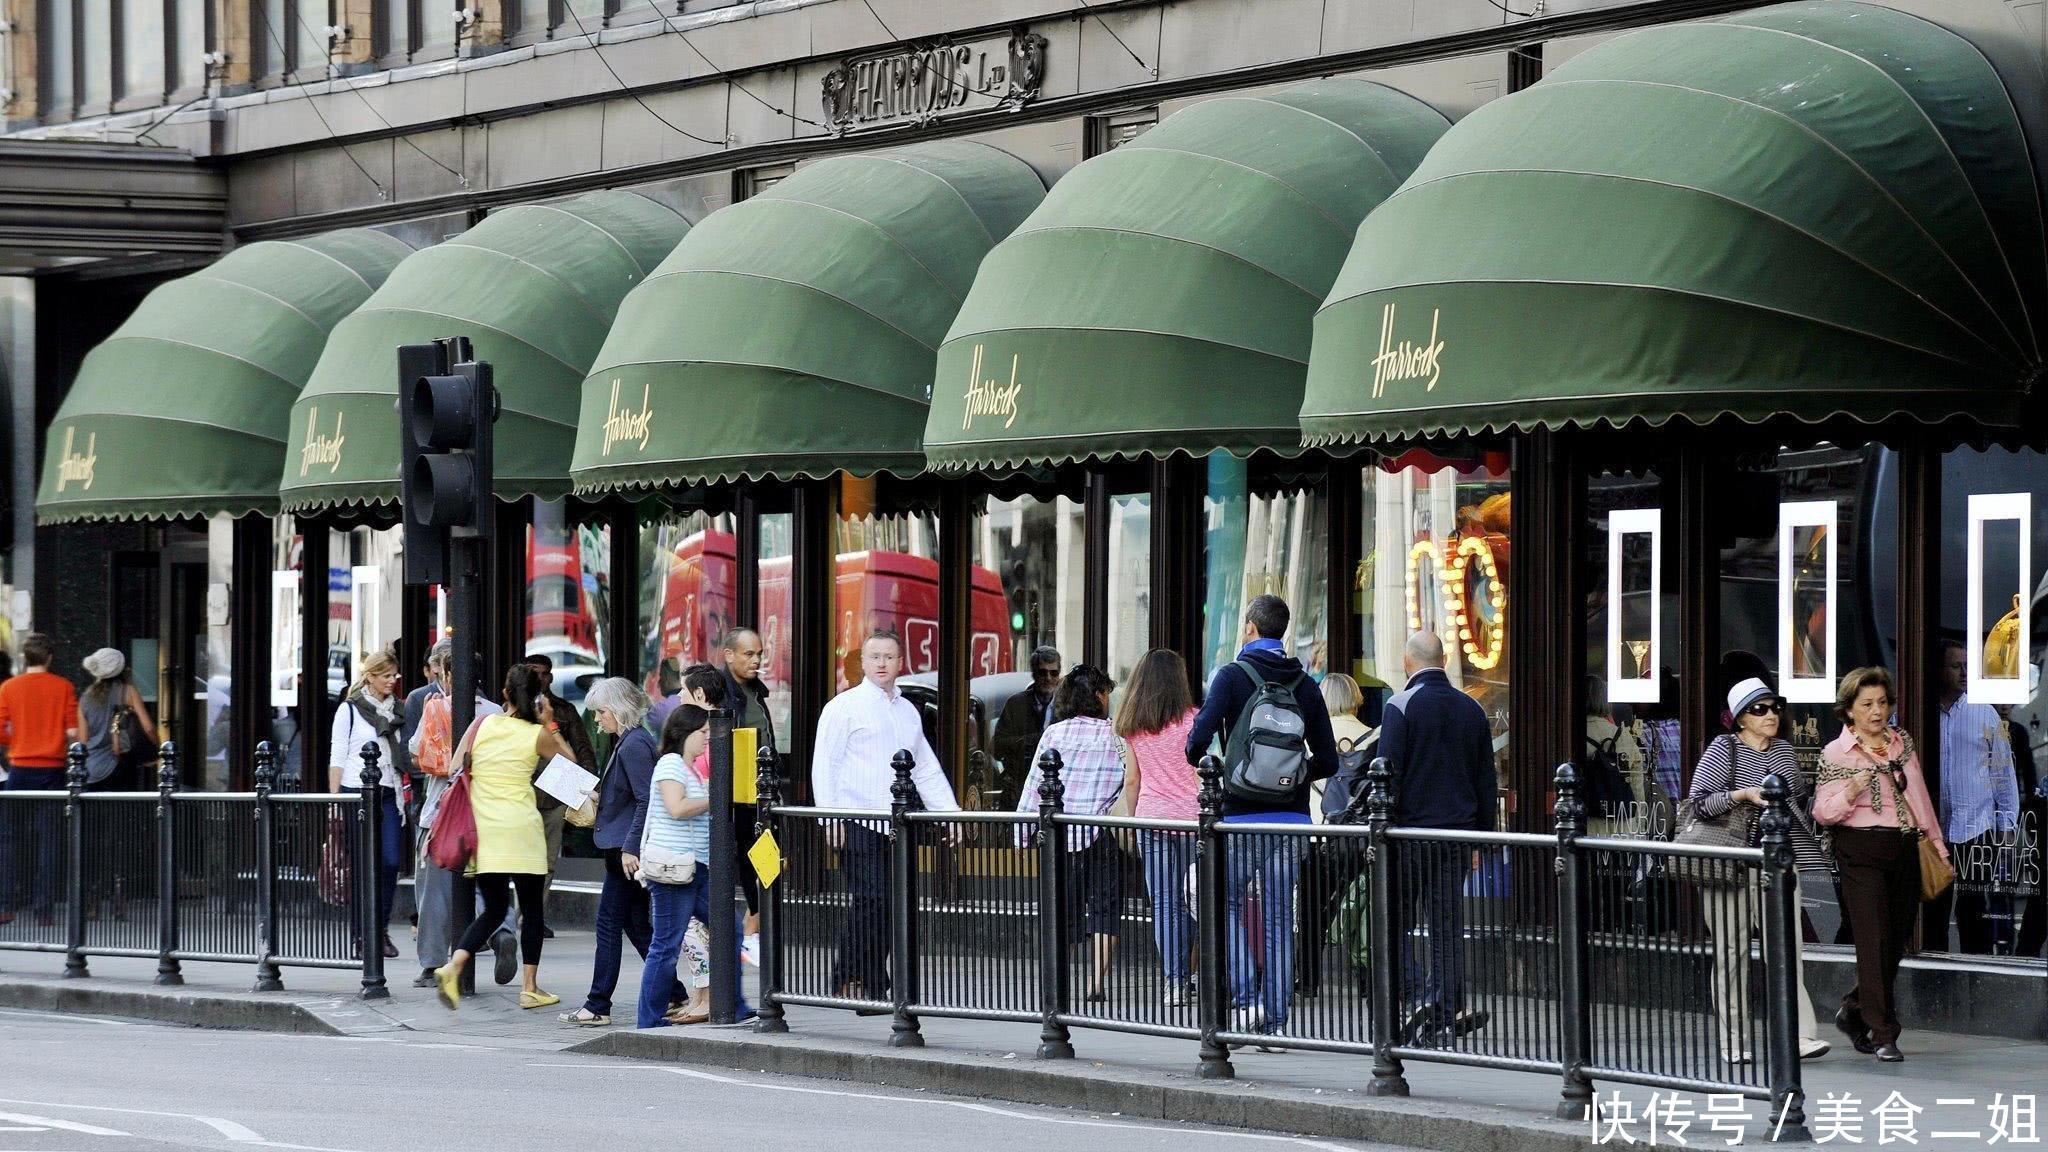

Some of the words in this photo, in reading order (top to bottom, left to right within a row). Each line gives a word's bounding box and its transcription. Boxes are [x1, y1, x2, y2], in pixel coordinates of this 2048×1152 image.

[855, 46, 971, 122] HARRODS
[1370, 302, 1445, 399] Harrods
[602, 378, 653, 456] Harrods
[962, 344, 1022, 431] Harrods
[300, 406, 345, 477] Harrods
[1604, 800, 1667, 835] HANDBAG
[1964, 809, 2038, 848] HANDBAG
[1953, 844, 2041, 885] NARRATIVES
